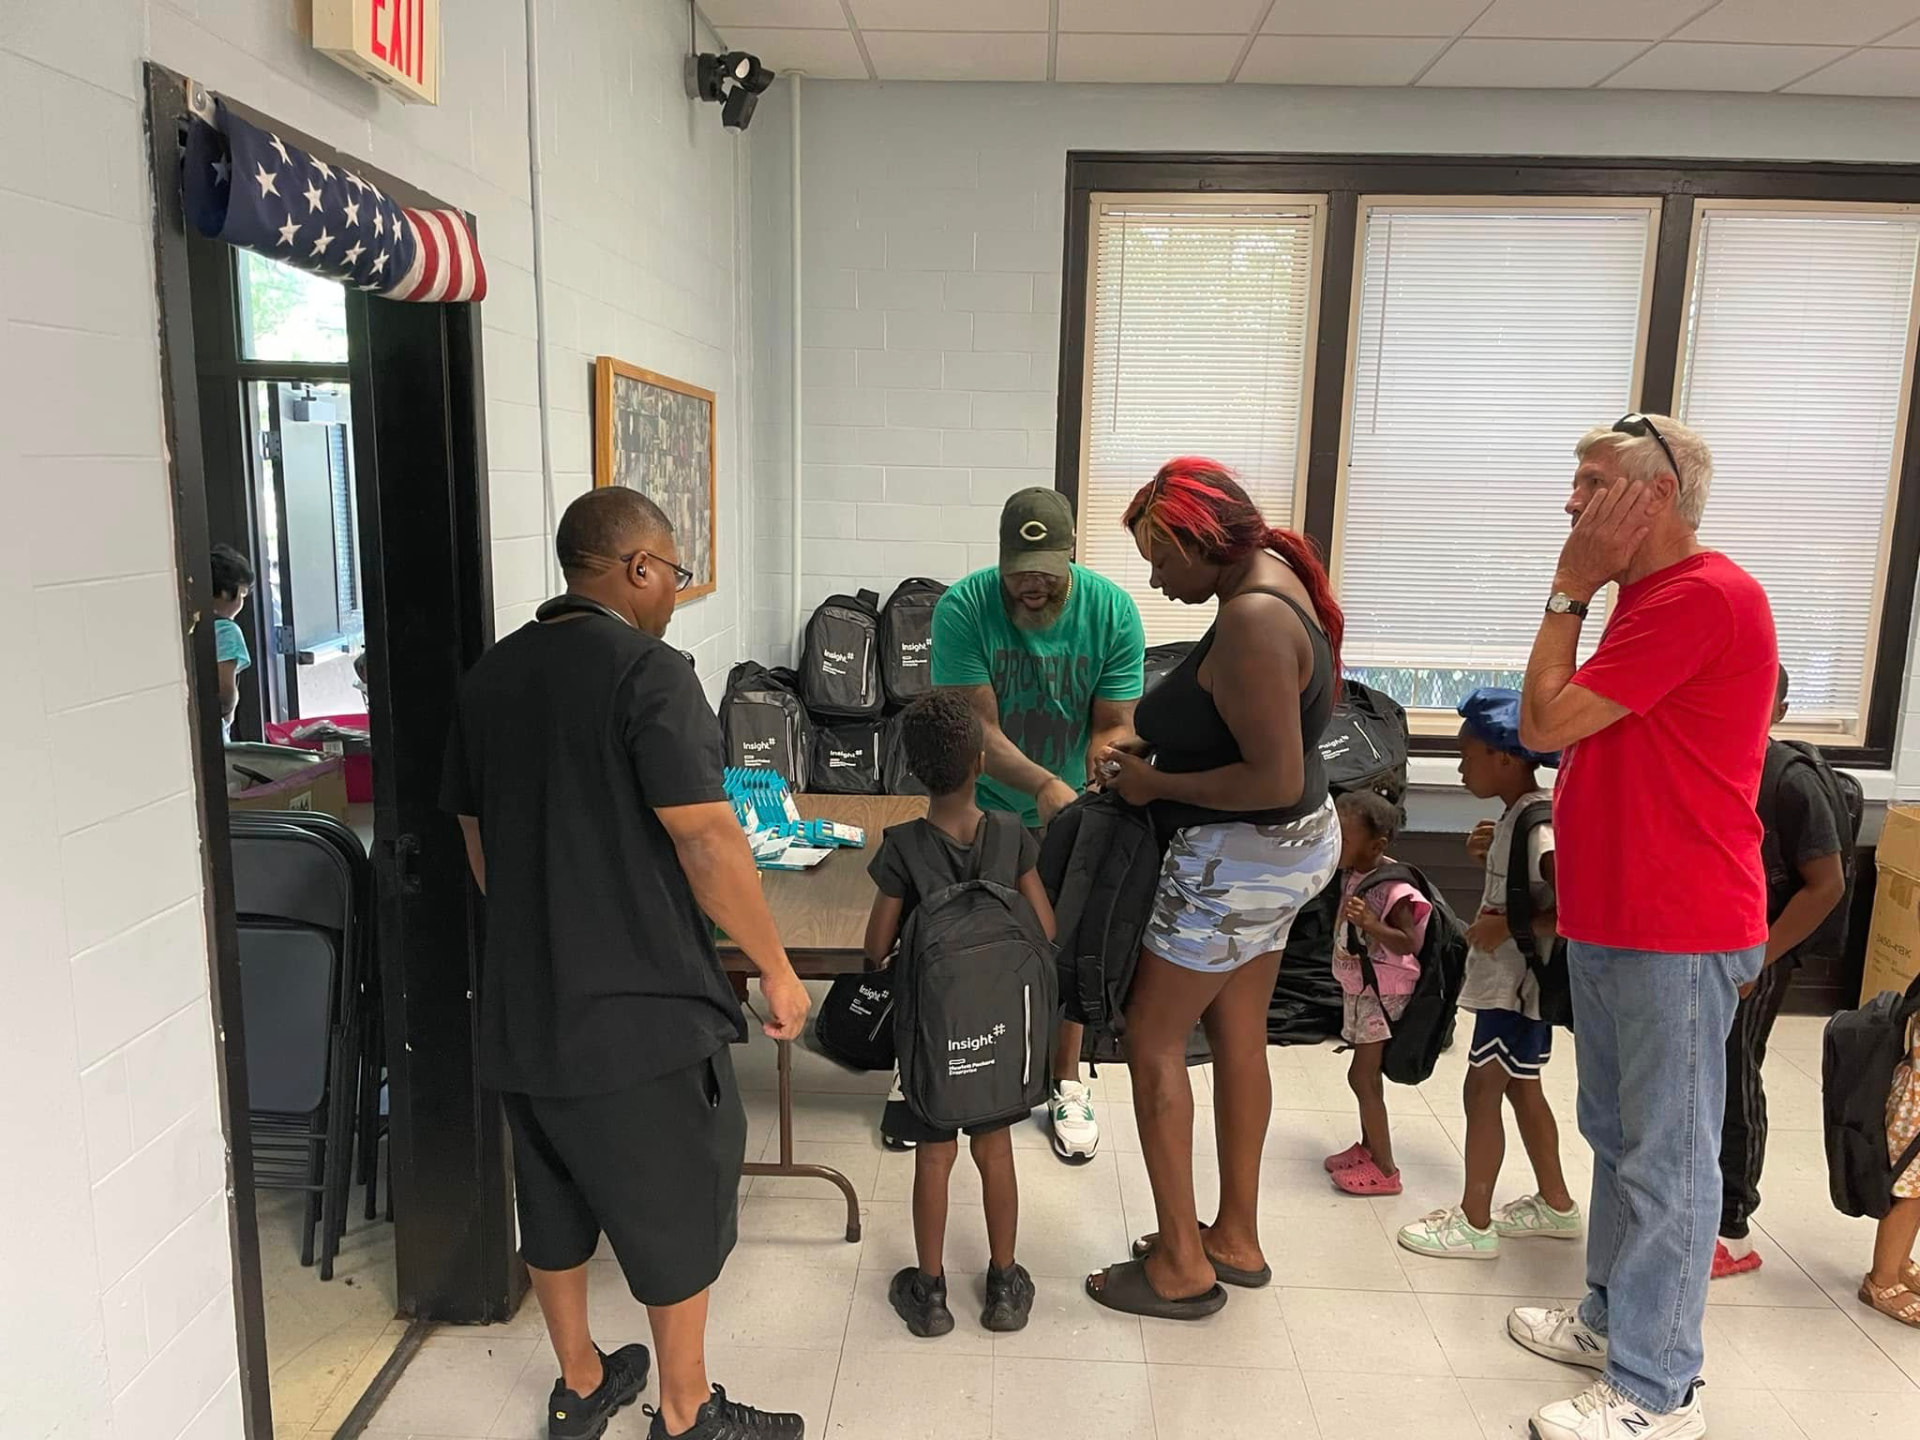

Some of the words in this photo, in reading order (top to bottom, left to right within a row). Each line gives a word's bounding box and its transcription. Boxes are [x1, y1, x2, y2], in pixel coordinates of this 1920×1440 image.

[1019, 520, 1048, 541] C
[1573, 1333, 1600, 1352] N
[1620, 1412, 1651, 1434] N
